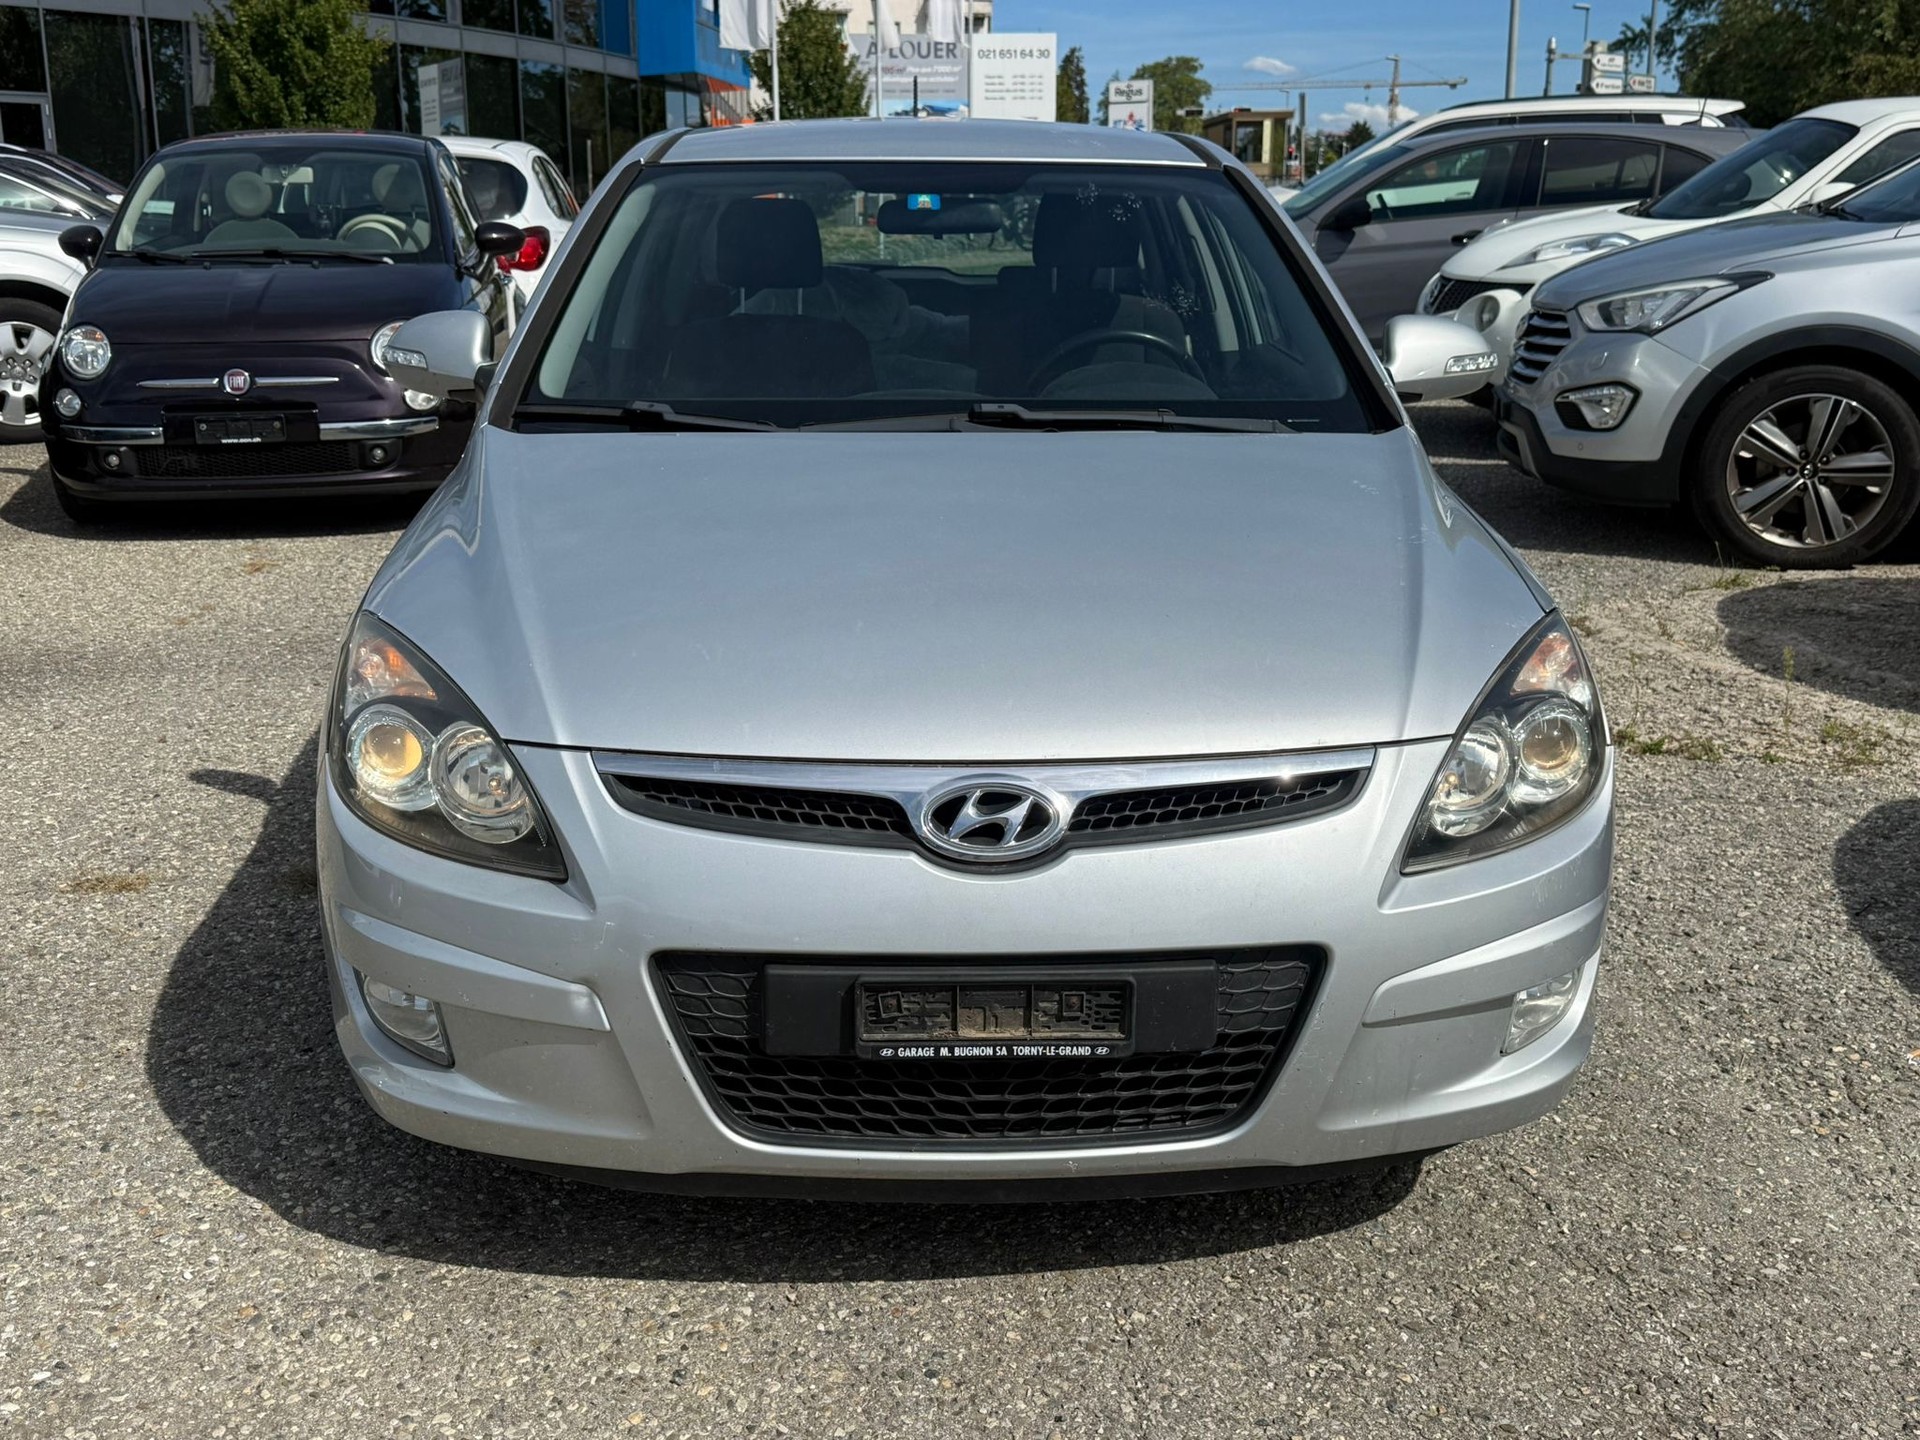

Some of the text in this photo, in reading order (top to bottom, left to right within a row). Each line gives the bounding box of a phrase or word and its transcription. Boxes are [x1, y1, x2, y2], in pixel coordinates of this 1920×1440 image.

[977, 49, 1051, 60] 021 651 64 30
[1114, 86, 1144, 101] Regus
[229, 376, 245, 388] FIAT
[897, 1046, 1092, 1057] GARAGE M. BUGNON SA TORNY-LE-GRAND
